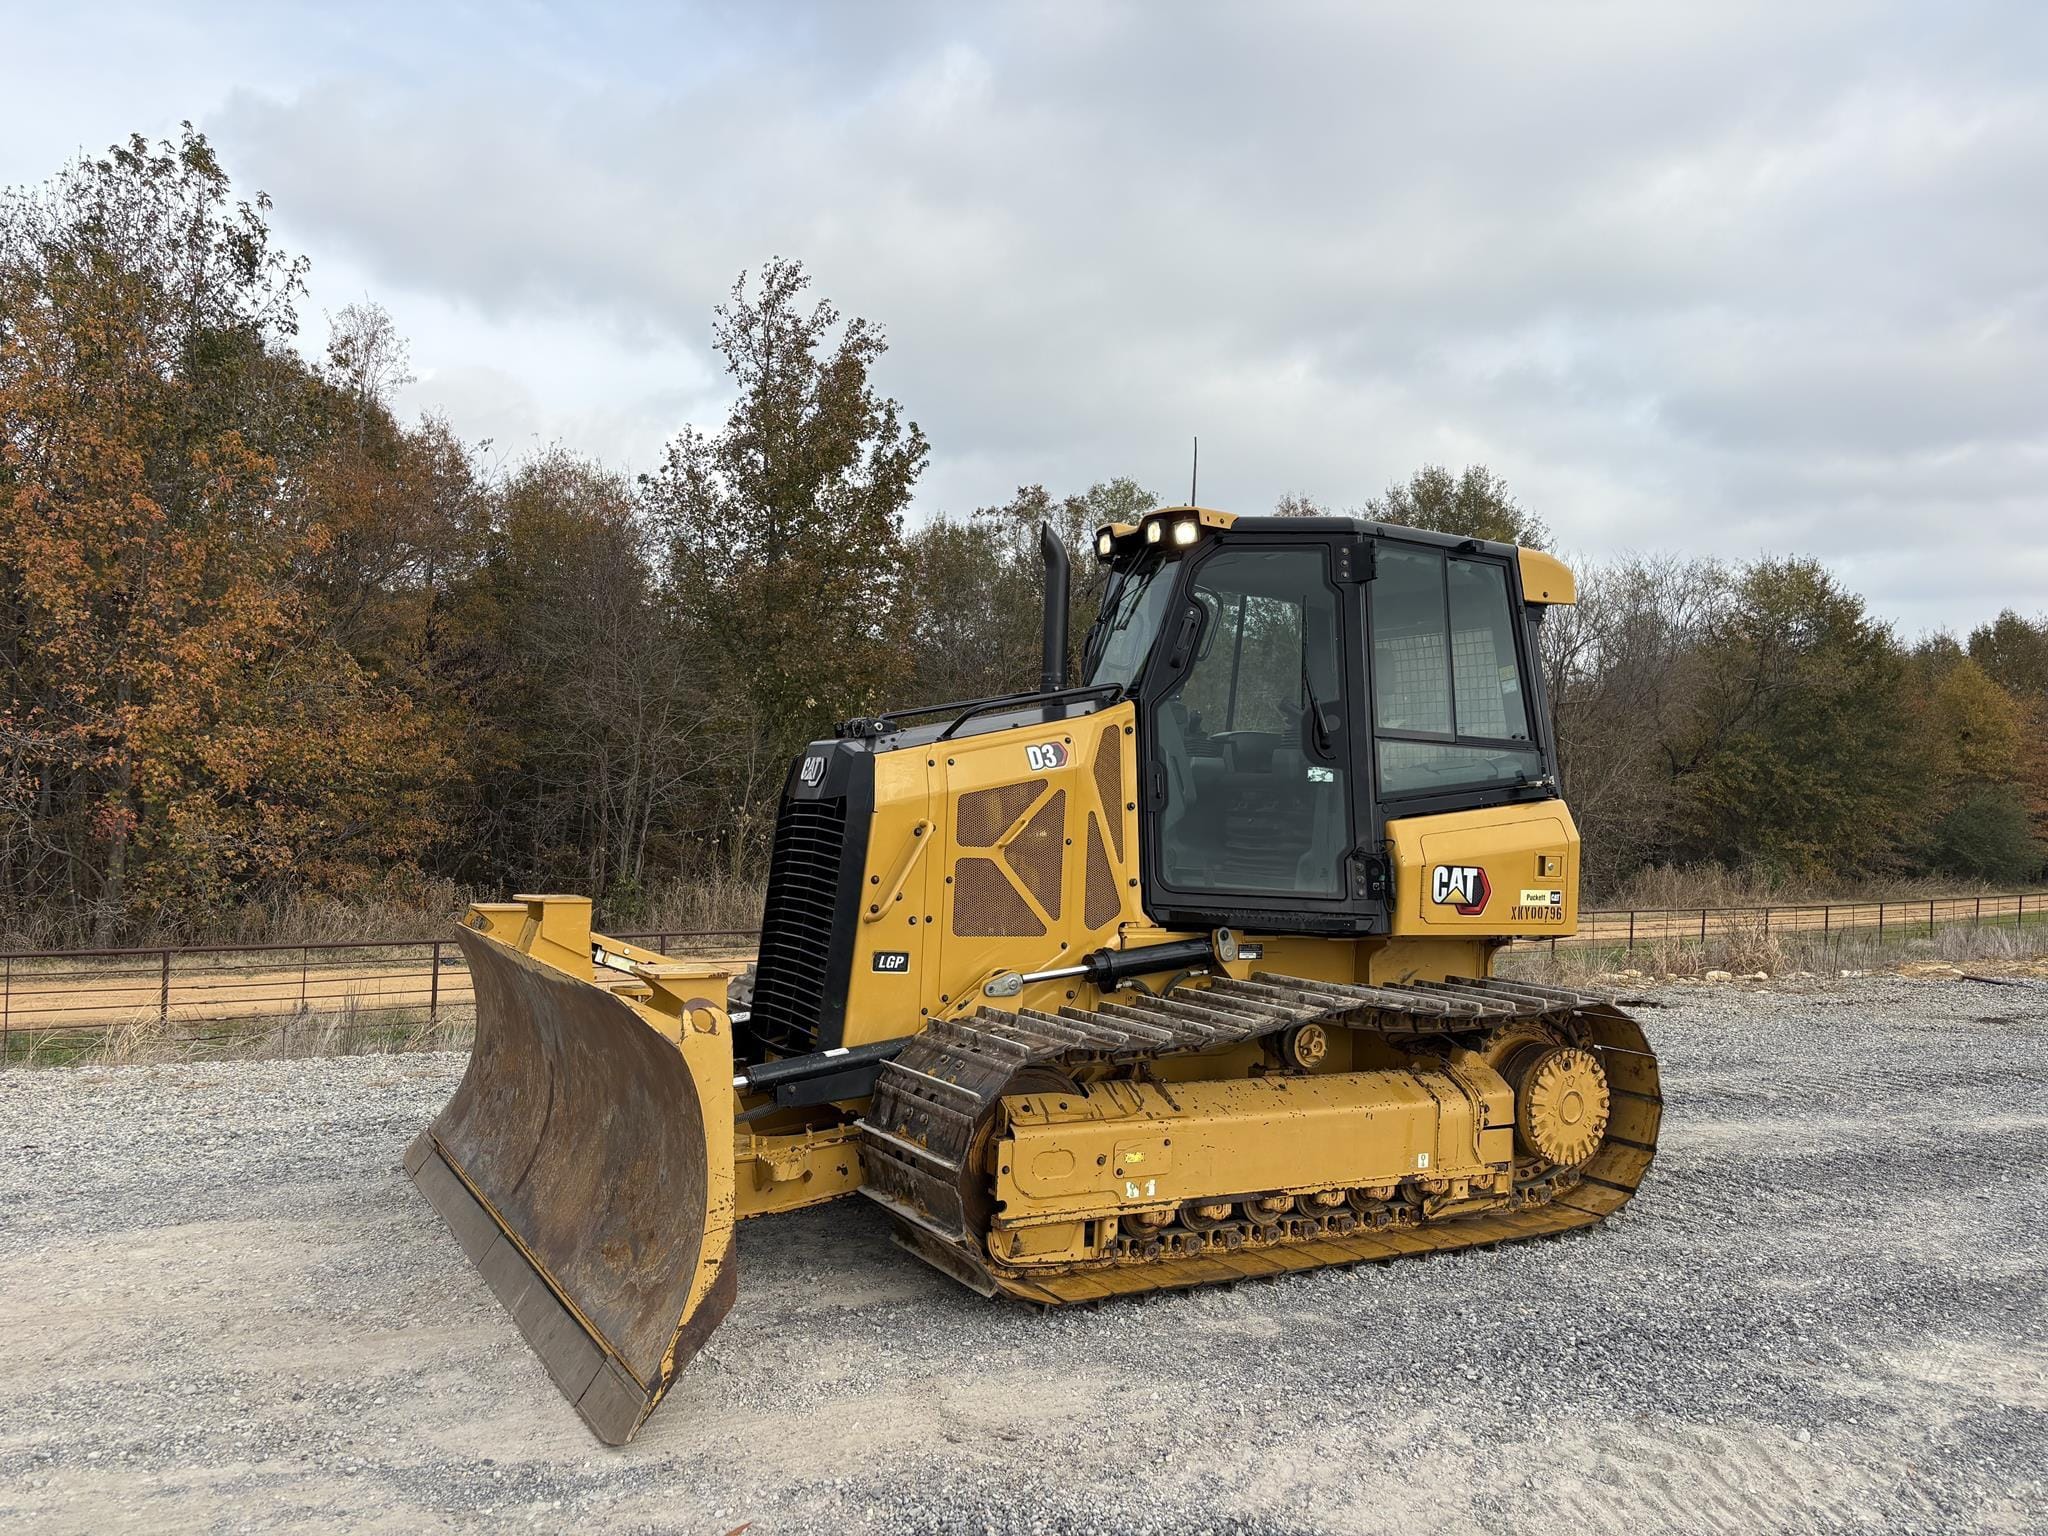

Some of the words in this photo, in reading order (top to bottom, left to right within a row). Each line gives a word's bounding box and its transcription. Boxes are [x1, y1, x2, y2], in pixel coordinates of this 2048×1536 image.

[1026, 744, 1057, 770] D3
[1432, 866, 1478, 904] CAT
[1526, 893, 1546, 901] Puckett
[1511, 906, 1562, 920] XKY00796
[878, 955, 905, 969] LGP
